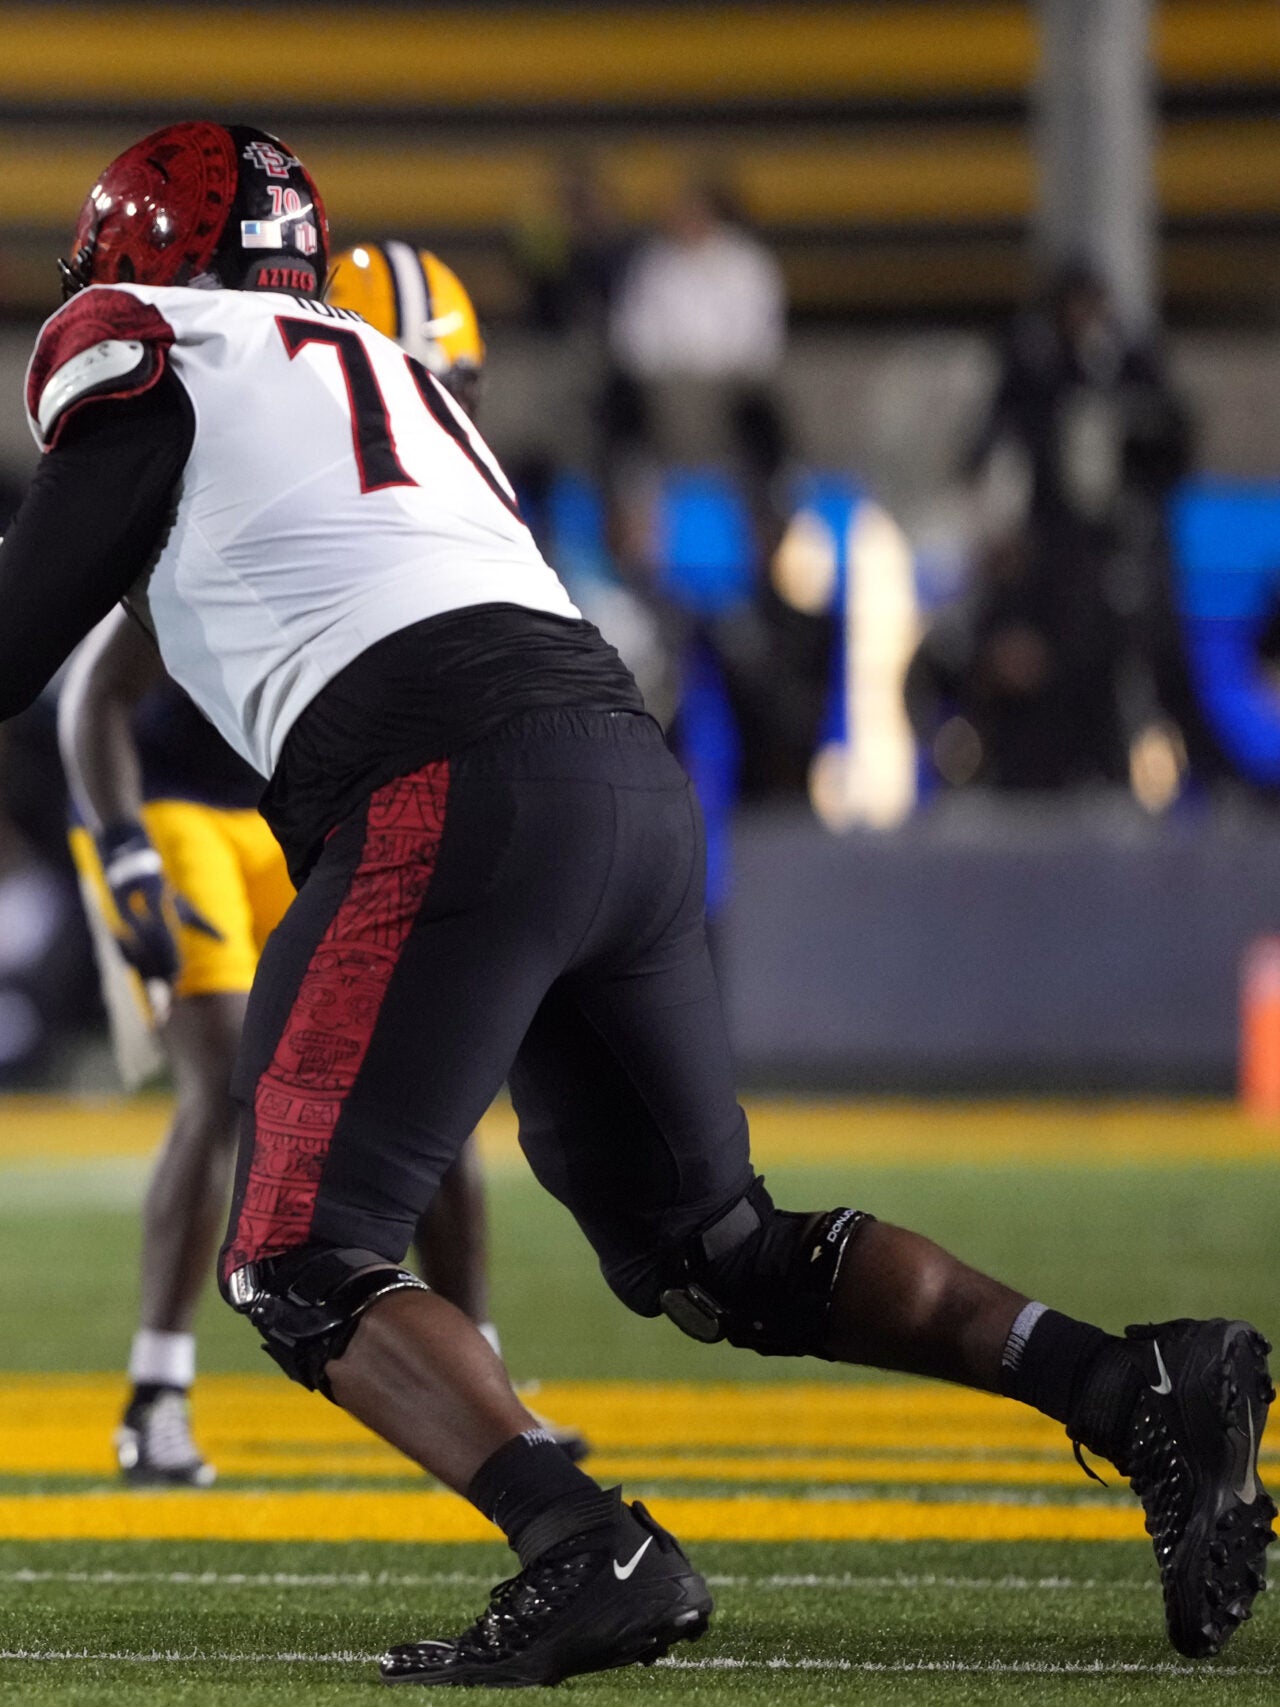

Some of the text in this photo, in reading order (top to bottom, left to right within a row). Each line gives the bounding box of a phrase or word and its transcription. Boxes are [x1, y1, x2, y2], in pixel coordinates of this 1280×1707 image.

[266, 185, 300, 216] 70
[257, 267, 315, 292] AZTECS
[827, 1209, 857, 1243] DONJO
